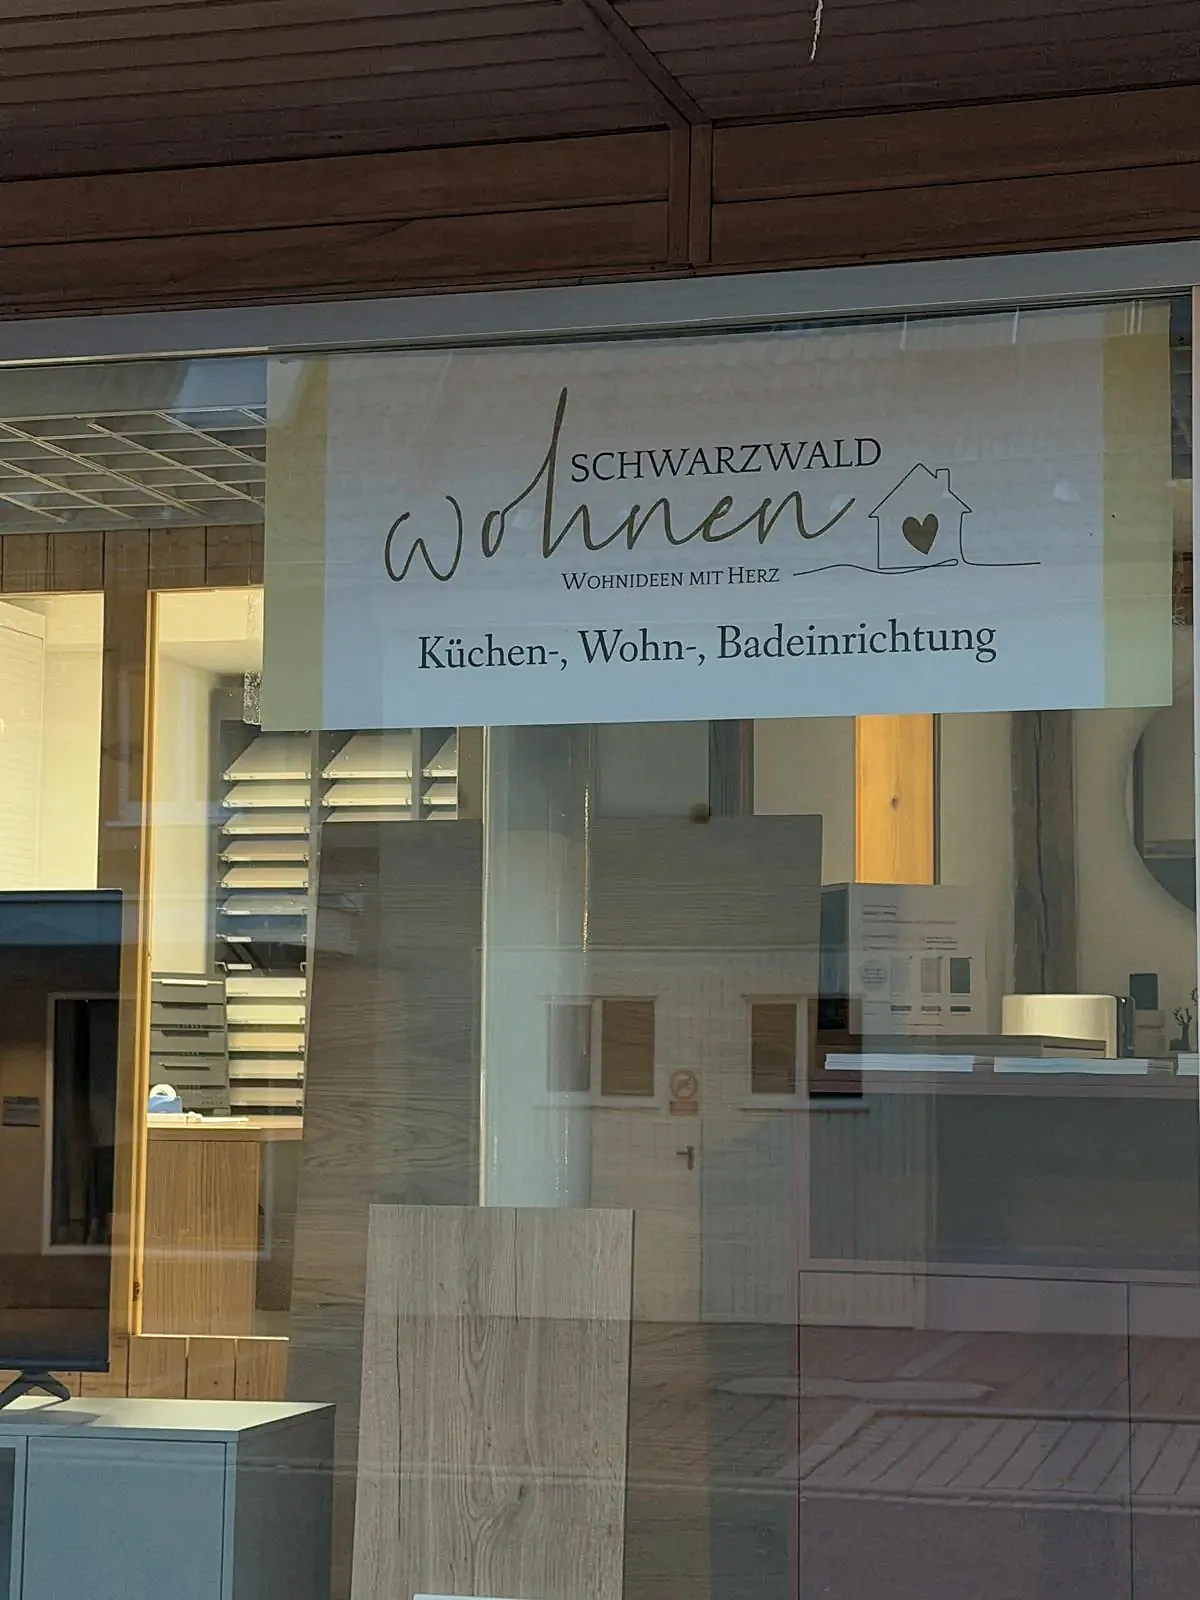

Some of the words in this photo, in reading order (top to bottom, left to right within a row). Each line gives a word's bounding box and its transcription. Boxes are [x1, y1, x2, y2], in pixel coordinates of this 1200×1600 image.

[384, 386, 857, 583] wohnen
[571, 437, 882, 482] SCHWARZWALD
[416, 634, 568, 672] Küchen-,
[576, 627, 706, 666] Wohn-,
[716, 618, 998, 664] Badeinrichtung
